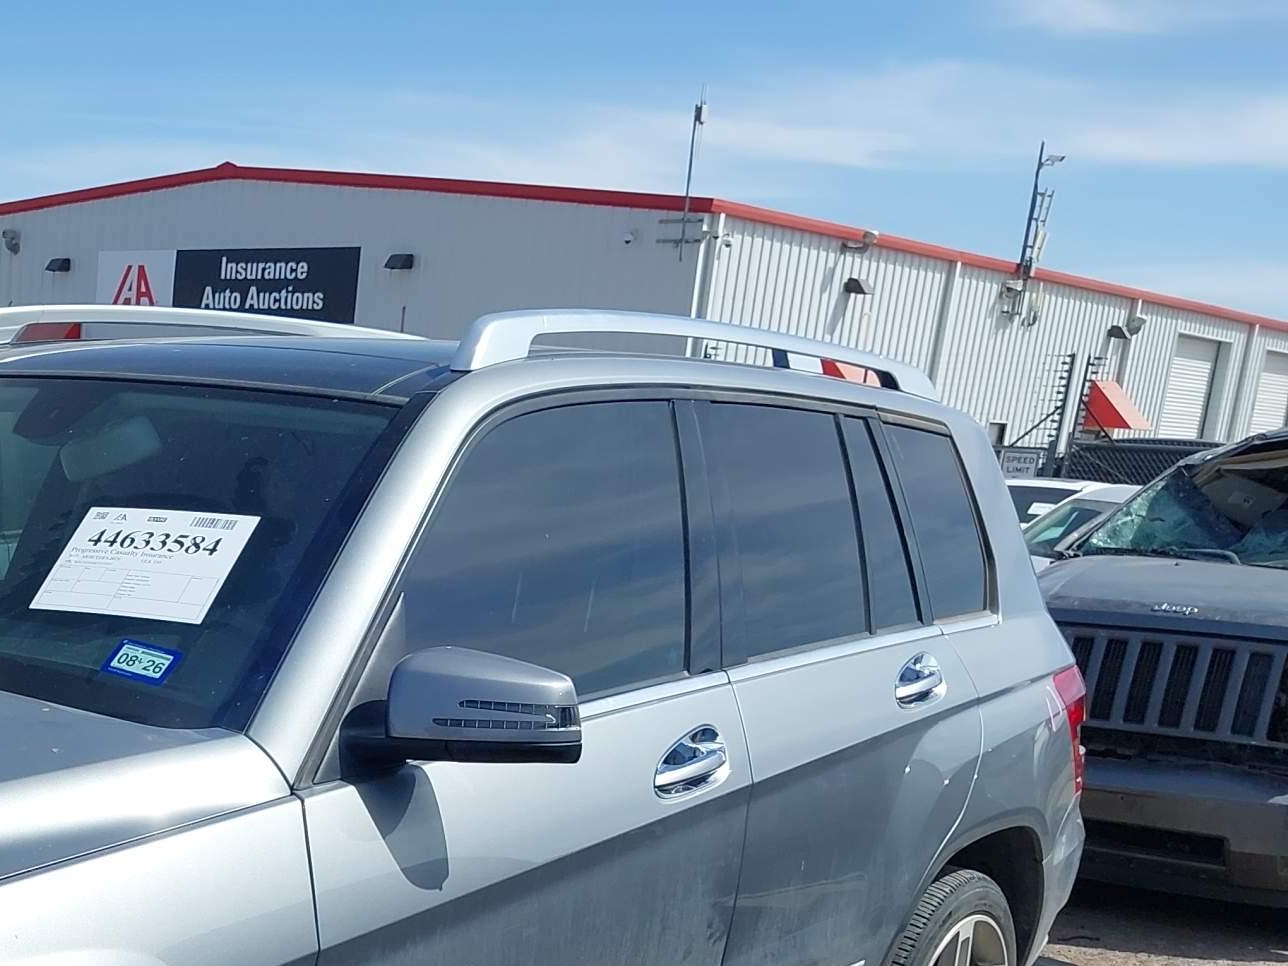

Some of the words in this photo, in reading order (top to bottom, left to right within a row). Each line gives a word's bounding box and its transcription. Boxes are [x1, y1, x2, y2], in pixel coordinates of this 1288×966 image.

[220, 256, 308, 280] Insurance
[200, 286, 240, 309] Auto
[244, 286, 324, 310] Auctions
[1006, 456, 1035, 464] SPEED
[88, 528, 223, 556] 44633584
[72, 546, 110, 555] Progressive
[110, 549, 140, 557] Casualty
[140, 551, 174, 559] Insurance
[1152, 602, 1199, 615] Jeep
